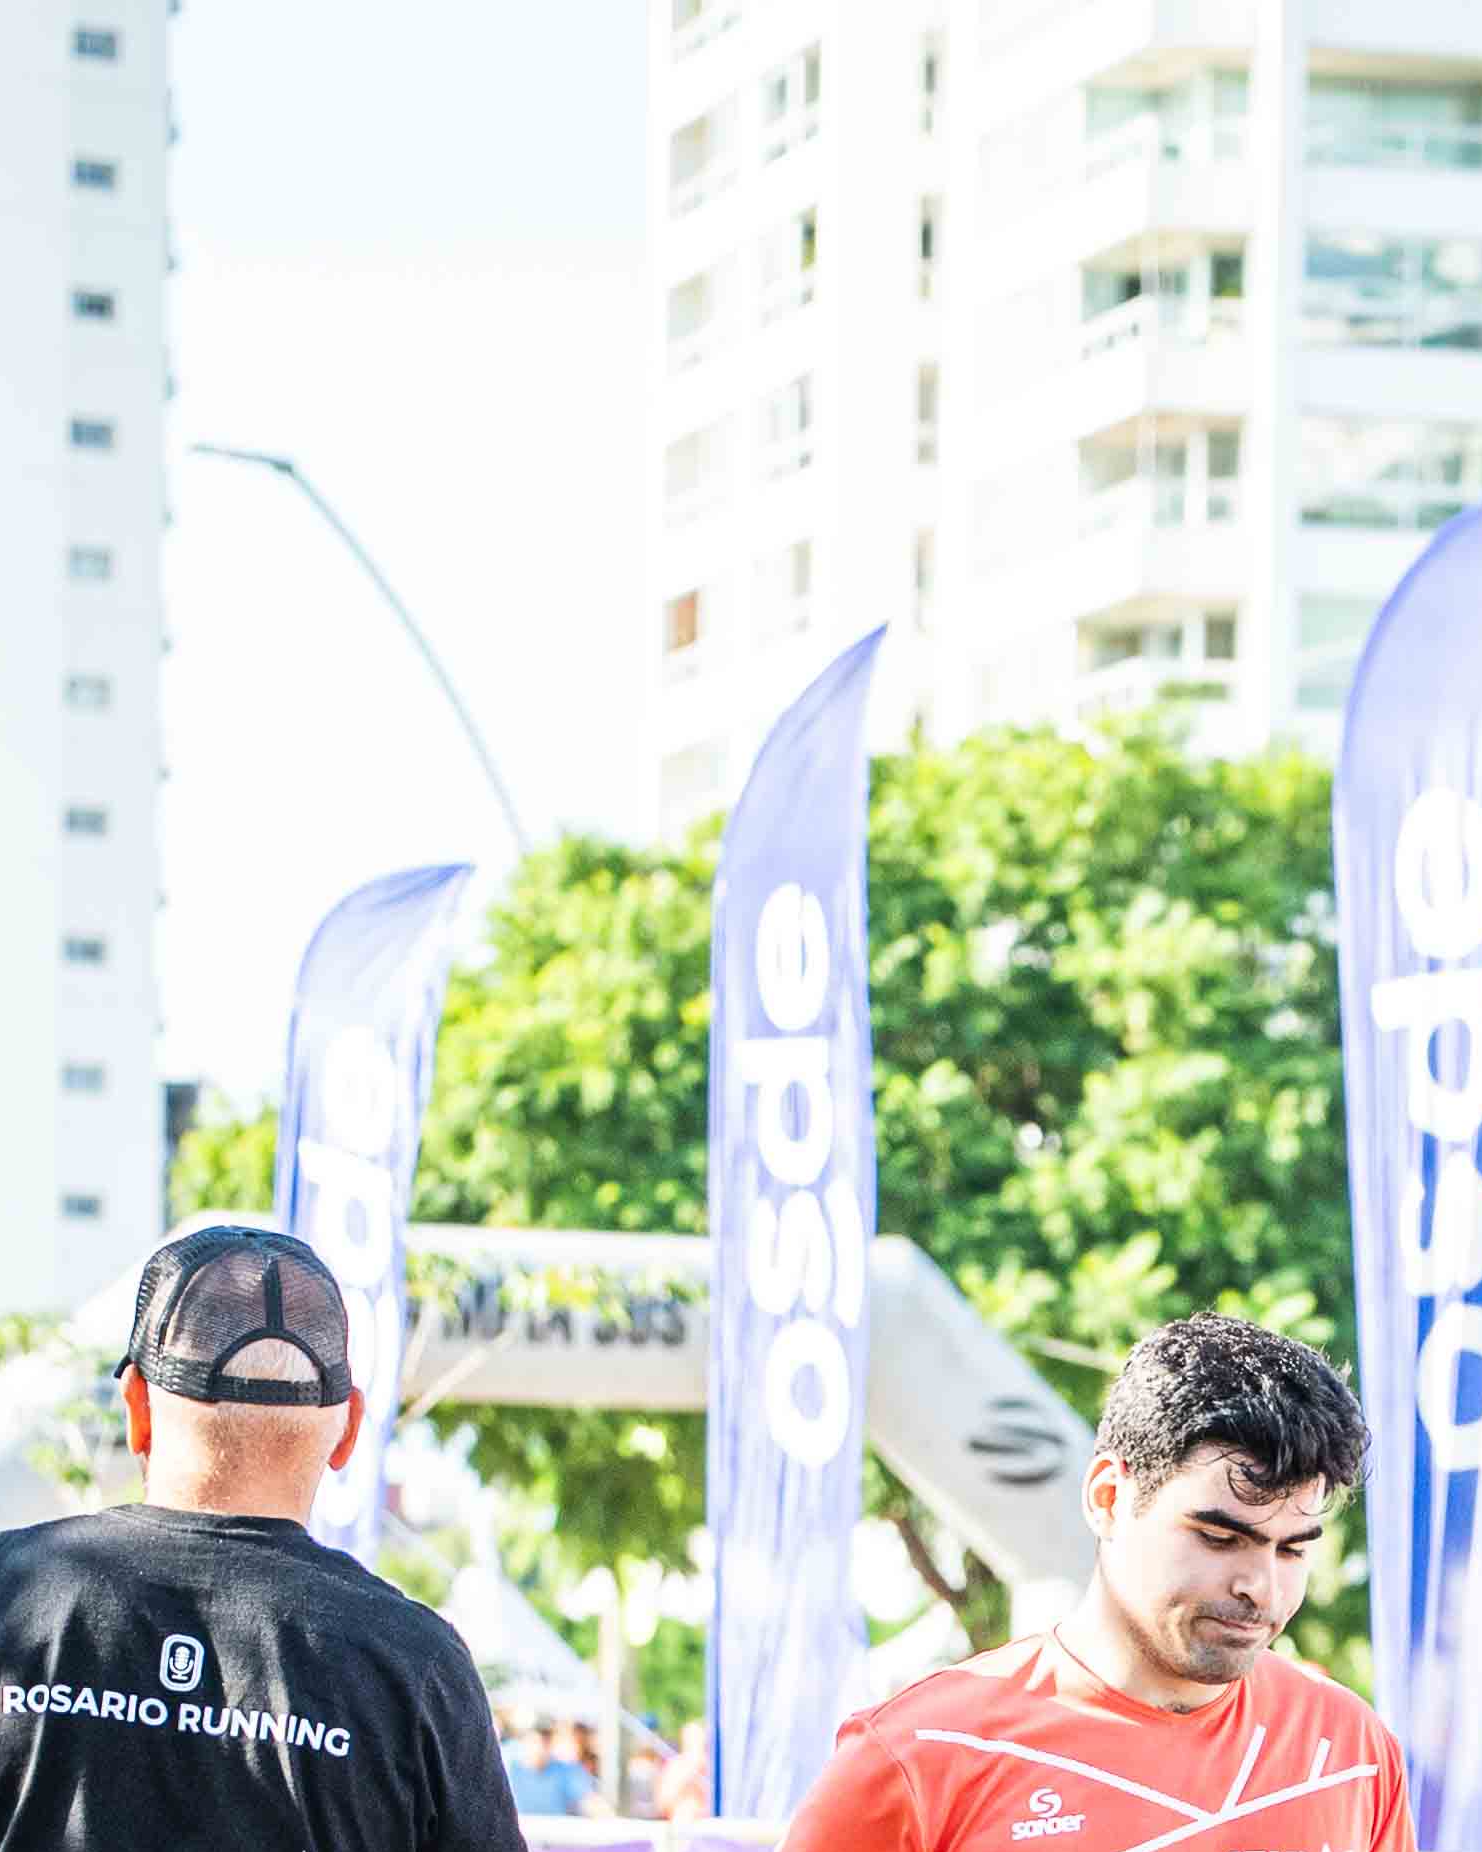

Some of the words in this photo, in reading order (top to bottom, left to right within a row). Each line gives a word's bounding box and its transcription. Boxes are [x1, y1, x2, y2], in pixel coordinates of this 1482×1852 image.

[733, 882, 865, 1469] osde
[2, 1684, 167, 1726] ROSARIO
[178, 1703, 350, 1757] RUNNING
